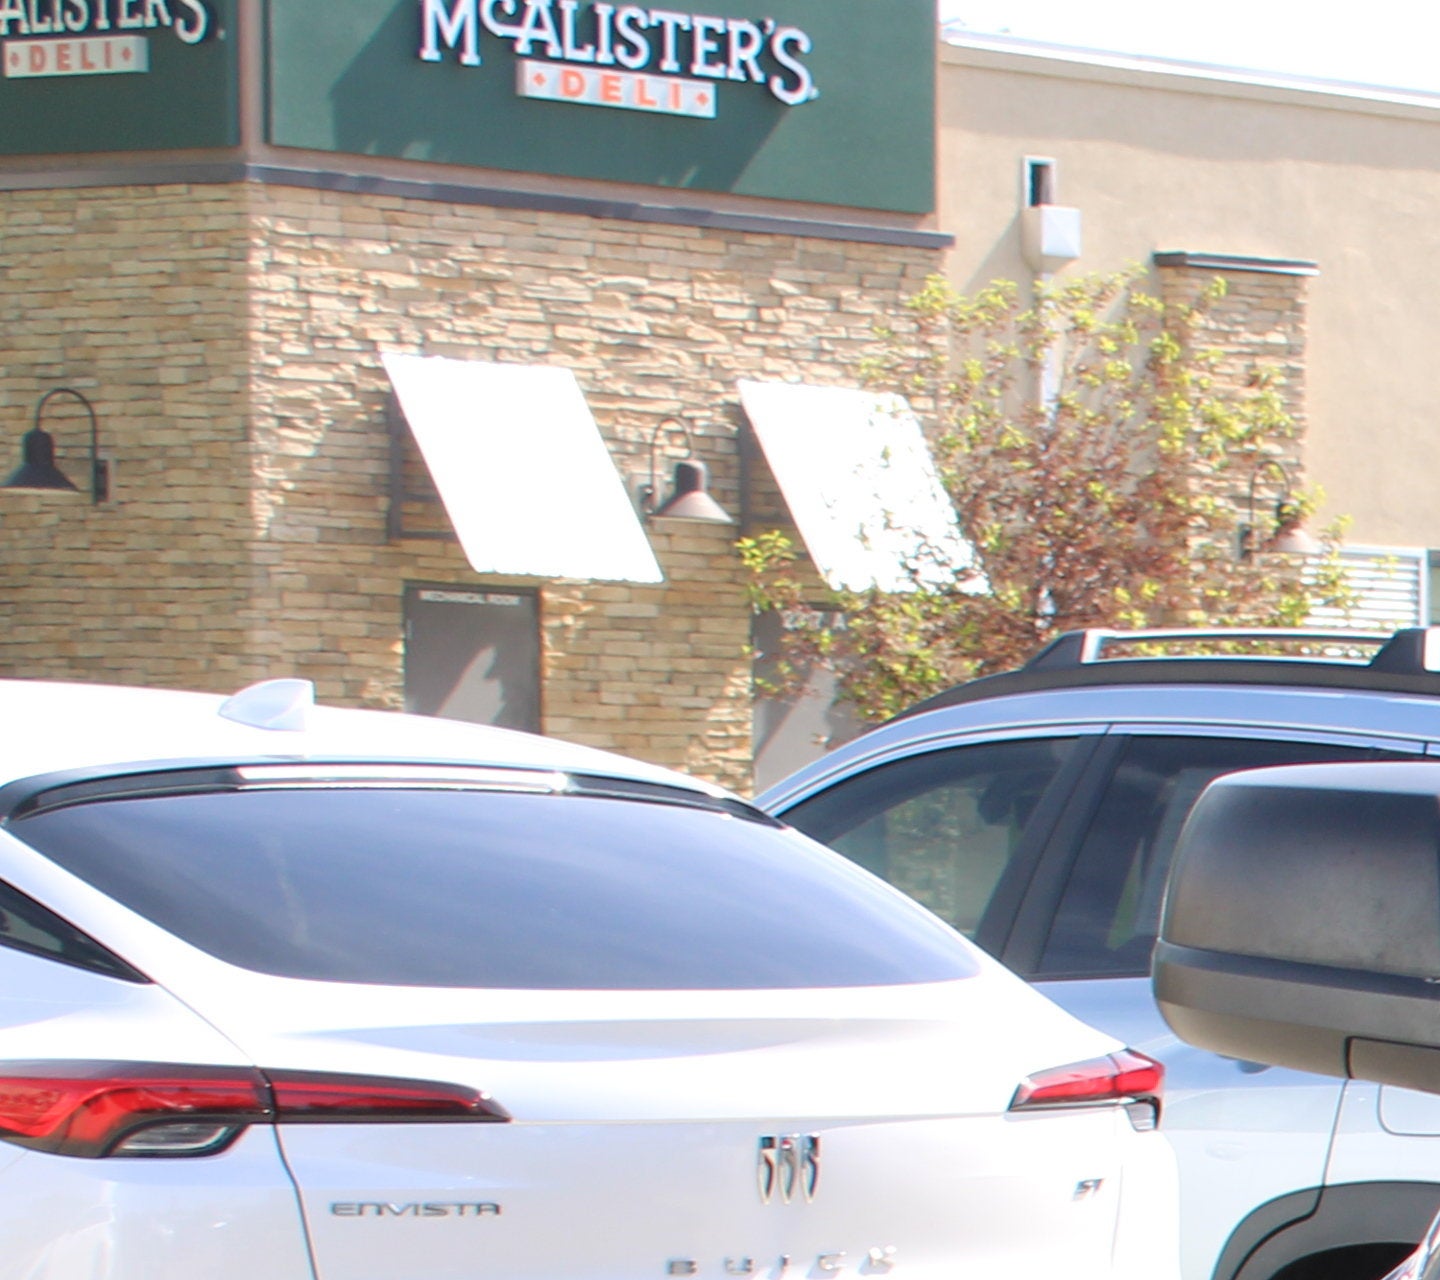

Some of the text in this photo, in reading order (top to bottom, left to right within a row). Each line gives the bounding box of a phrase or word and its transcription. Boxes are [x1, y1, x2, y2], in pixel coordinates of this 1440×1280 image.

[29, 41, 114, 73] DELI
[559, 69, 682, 109] DELI
[329, 1202, 502, 1217] ENVISTA
[667, 1244, 897, 1276] BUICK
